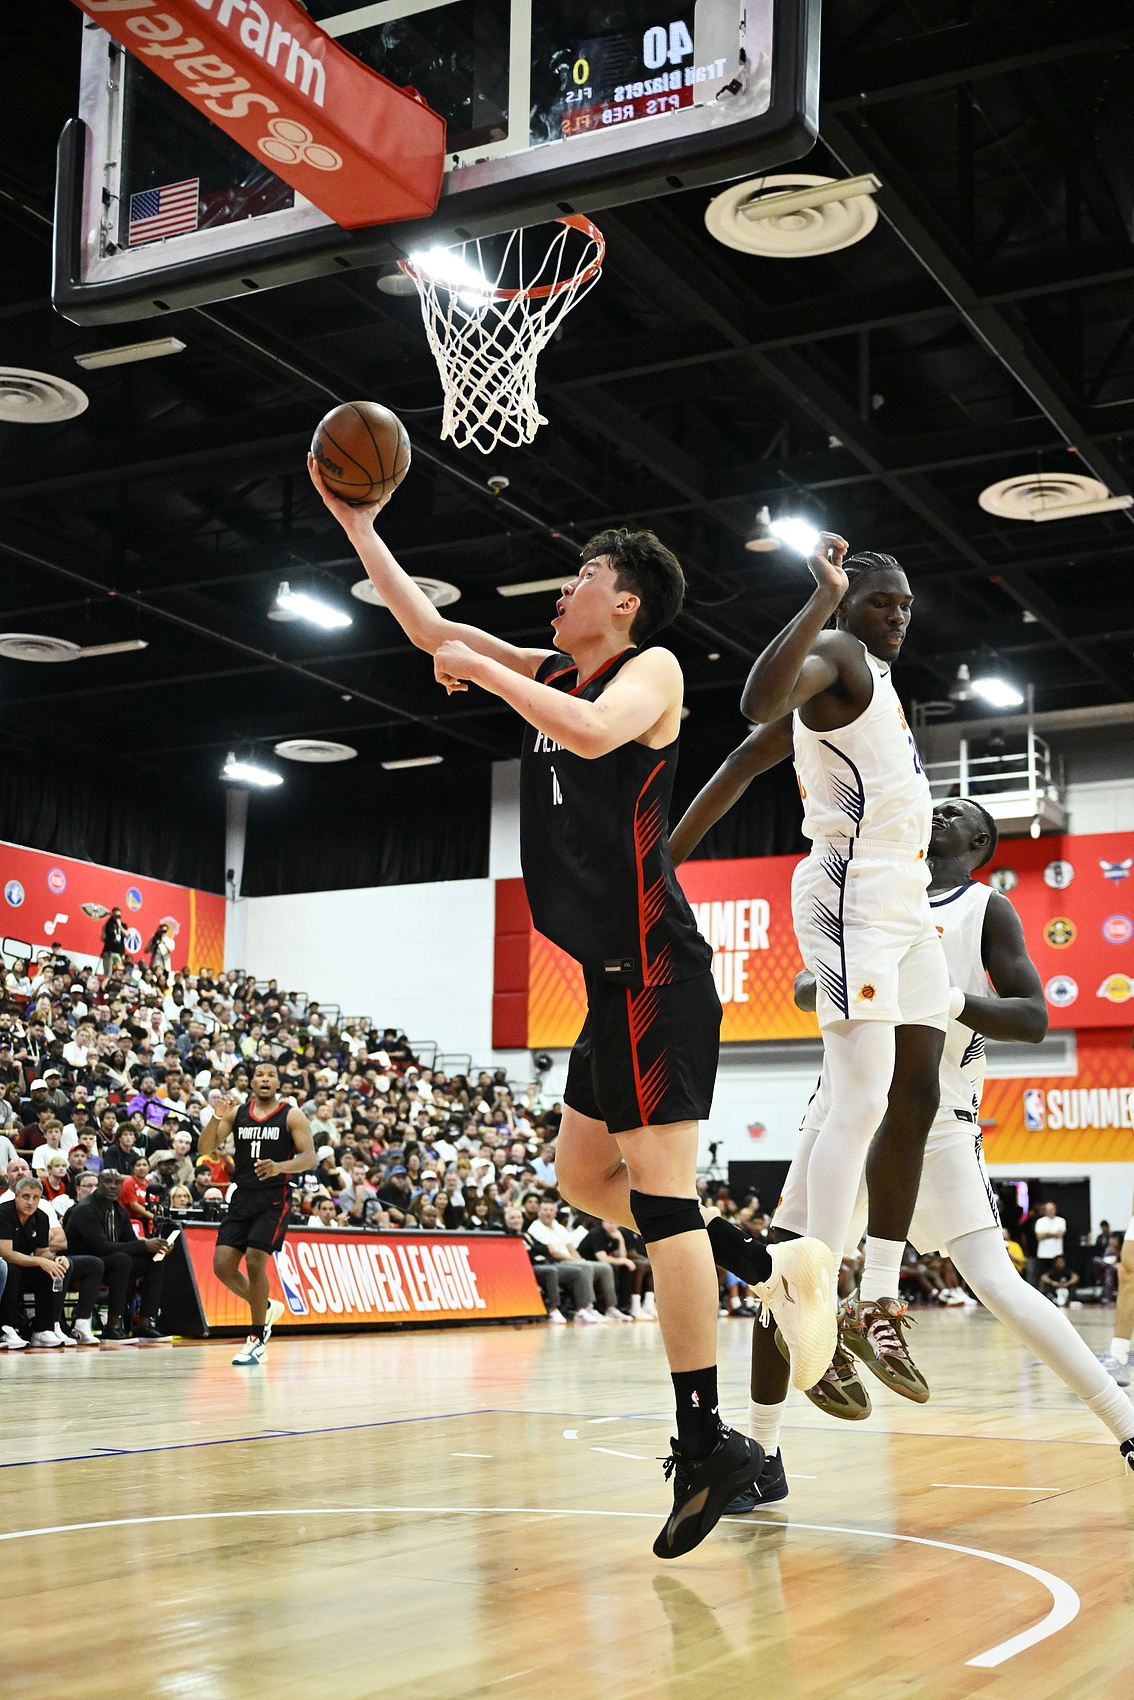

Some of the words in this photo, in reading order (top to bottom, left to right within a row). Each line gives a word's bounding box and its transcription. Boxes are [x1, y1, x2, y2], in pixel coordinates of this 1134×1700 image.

[125, 13, 279, 119] State
[238, 1126, 280, 1141] PORTLAND
[250, 1140, 261, 1159] 11
[297, 1241, 411, 1314] SUMMER
[396, 1245, 487, 1312] LEAGUE
